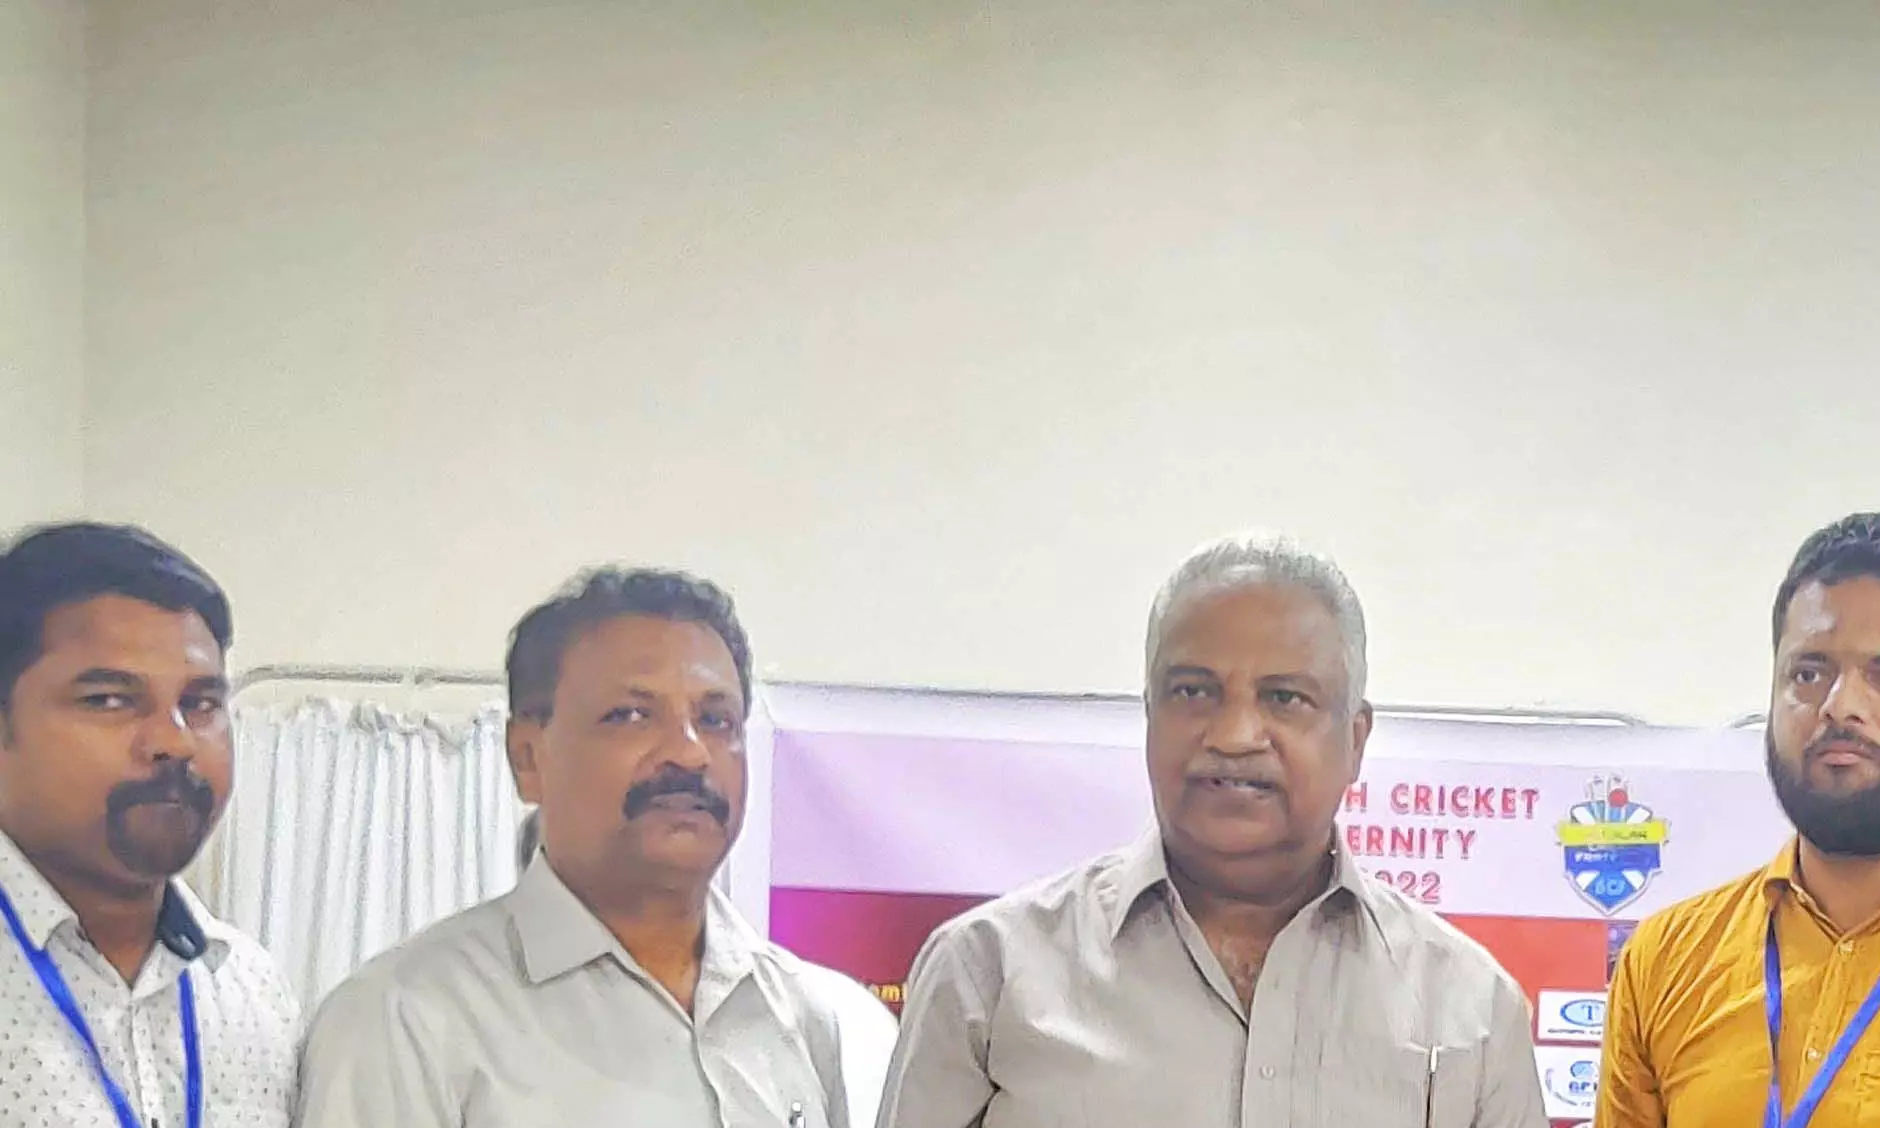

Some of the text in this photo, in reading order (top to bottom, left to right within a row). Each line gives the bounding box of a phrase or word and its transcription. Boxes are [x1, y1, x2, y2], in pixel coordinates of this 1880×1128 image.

[1344, 781, 1540, 819] H CRICKET
[1346, 824, 1476, 860] ERNITY
